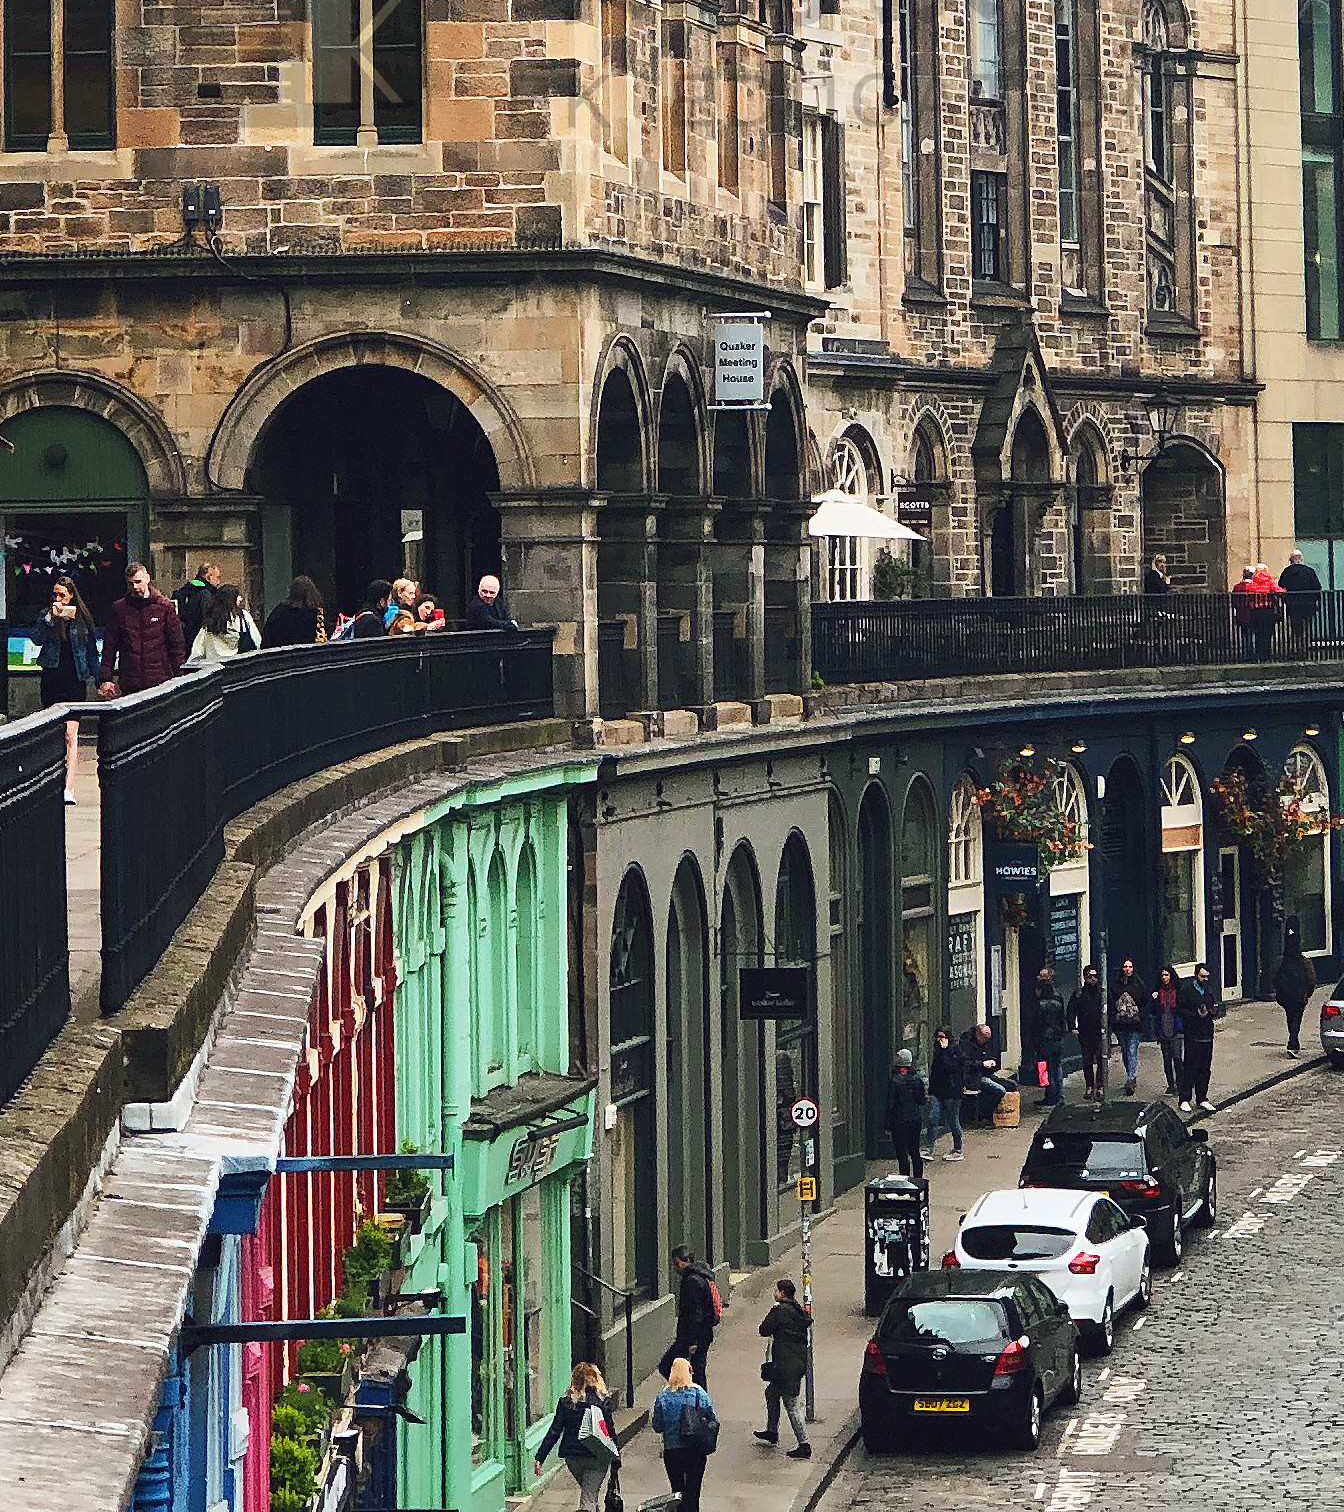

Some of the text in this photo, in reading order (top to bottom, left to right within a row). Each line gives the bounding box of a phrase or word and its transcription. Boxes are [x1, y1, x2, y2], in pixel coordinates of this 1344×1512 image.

[719, 341, 756, 351] Quaker
[719, 357, 758, 368] Meeting
[722, 374, 754, 383] House
[995, 866, 1037, 875] HOWIES
[794, 1107, 816, 1120] 20
